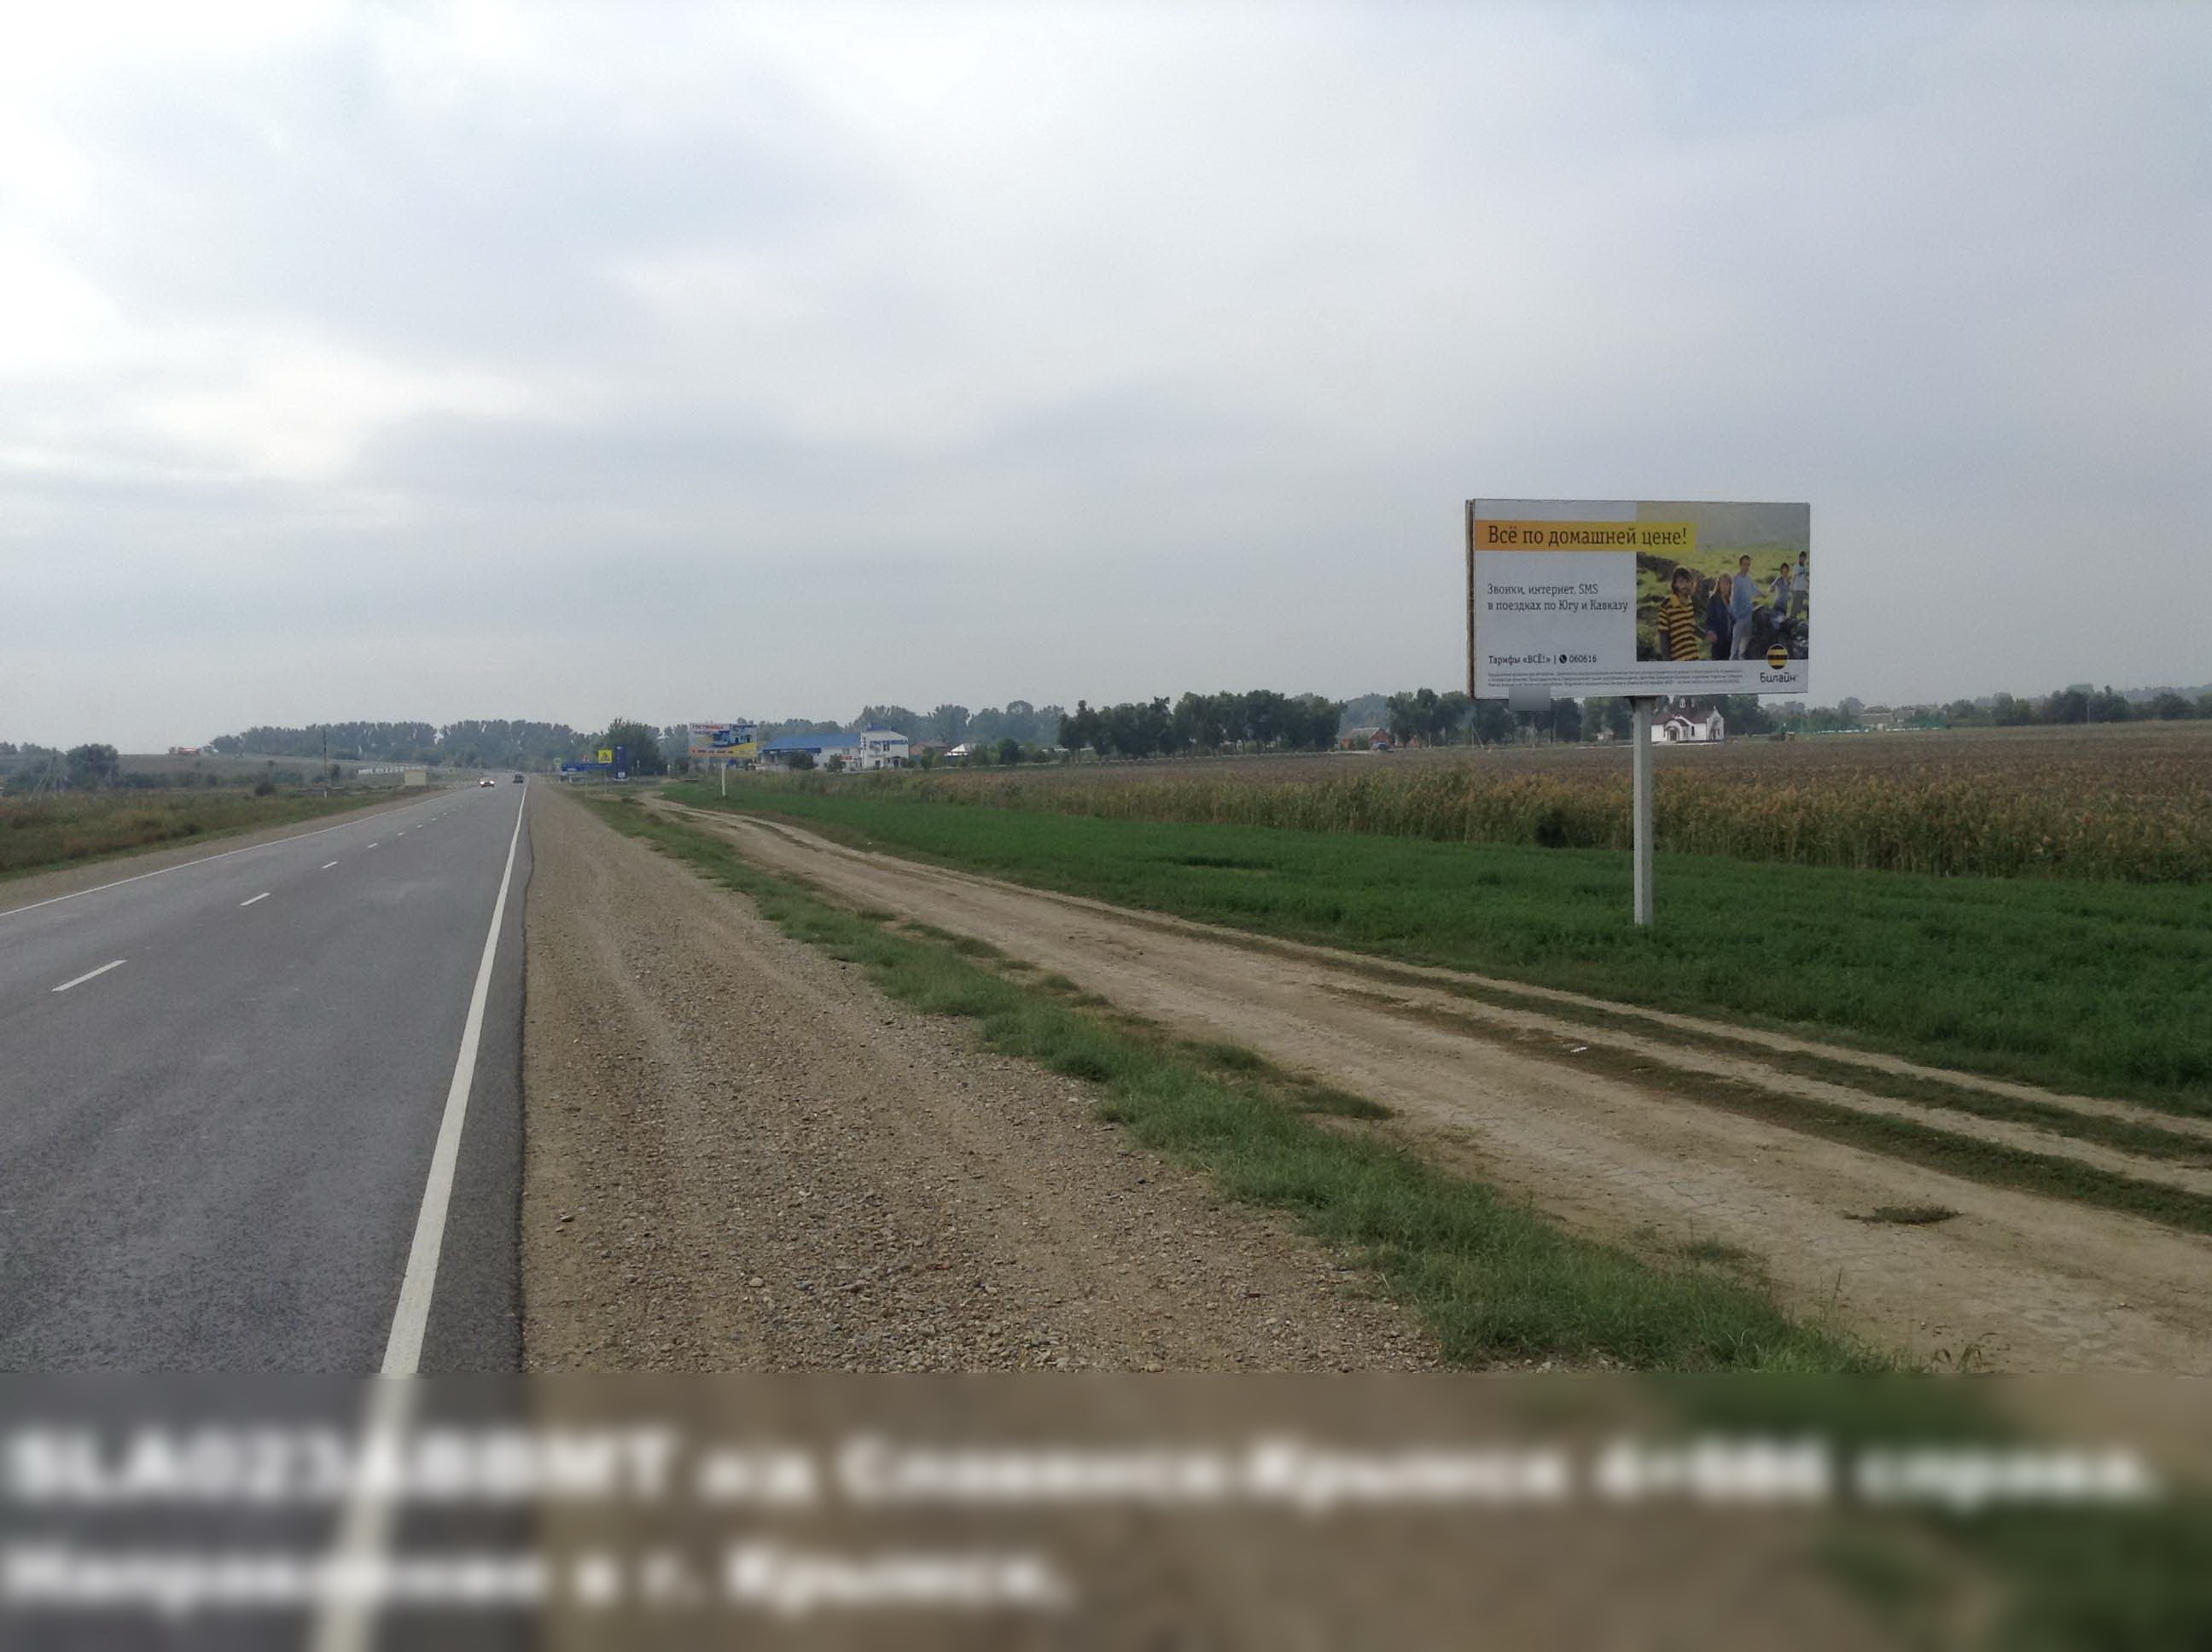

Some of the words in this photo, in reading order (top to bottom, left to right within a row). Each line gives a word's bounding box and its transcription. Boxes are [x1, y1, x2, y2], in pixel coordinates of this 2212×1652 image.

[1487, 525, 1517, 544] Всё
[1522, 530, 1544, 544] по
[1548, 527, 1636, 546] домашней
[1642, 527, 1686, 547] цене!
[1487, 583, 1525, 596] Звонки,
[1579, 583, 1598, 595] SMS
[1487, 602, 1493, 610] в
[1496, 602, 1541, 611] поездках
[1544, 602, 1557, 610] по
[1558, 599, 1579, 613] Югу
[1581, 602, 1587, 610] и
[1590, 600, 1628, 613] Кавказу
[1488, 655, 1521, 666] Тарифы
